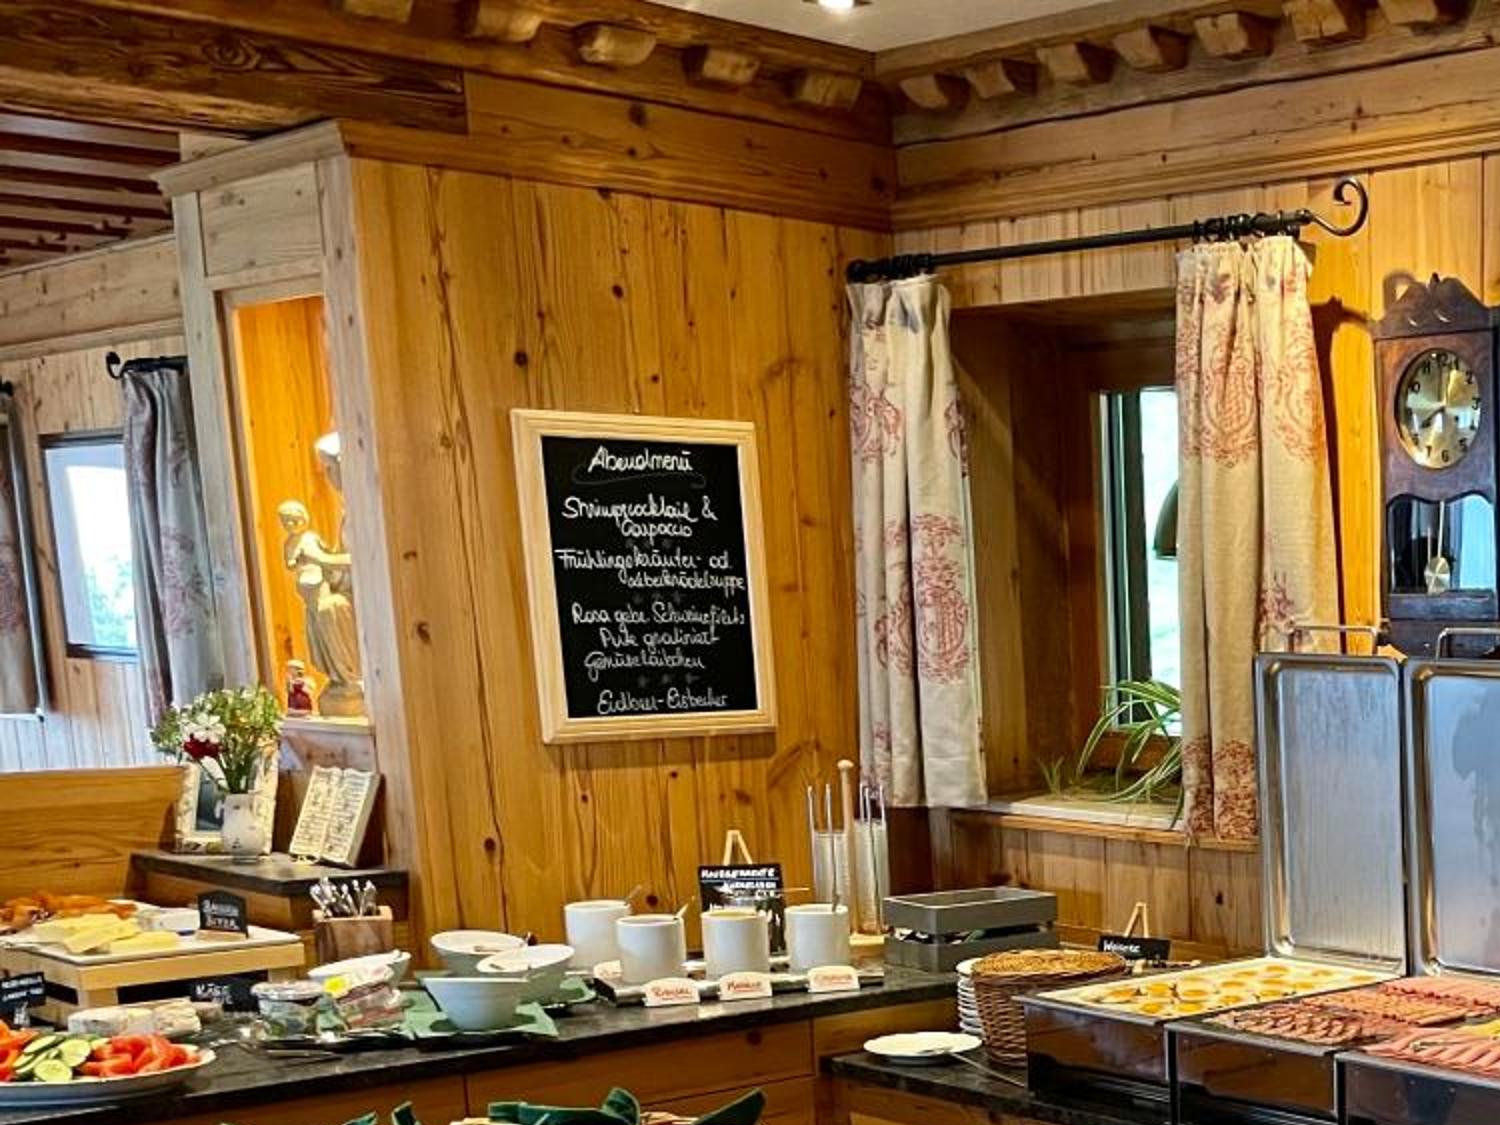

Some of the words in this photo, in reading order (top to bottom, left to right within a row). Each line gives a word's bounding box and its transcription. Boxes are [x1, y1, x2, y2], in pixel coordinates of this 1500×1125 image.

[587, 445, 693, 472] Abendmenü
[1441, 449, 1450, 463] 6
[702, 496, 719, 521] &
[620, 519, 693, 546] Carpaccio
[571, 601, 612, 625] Rosa
